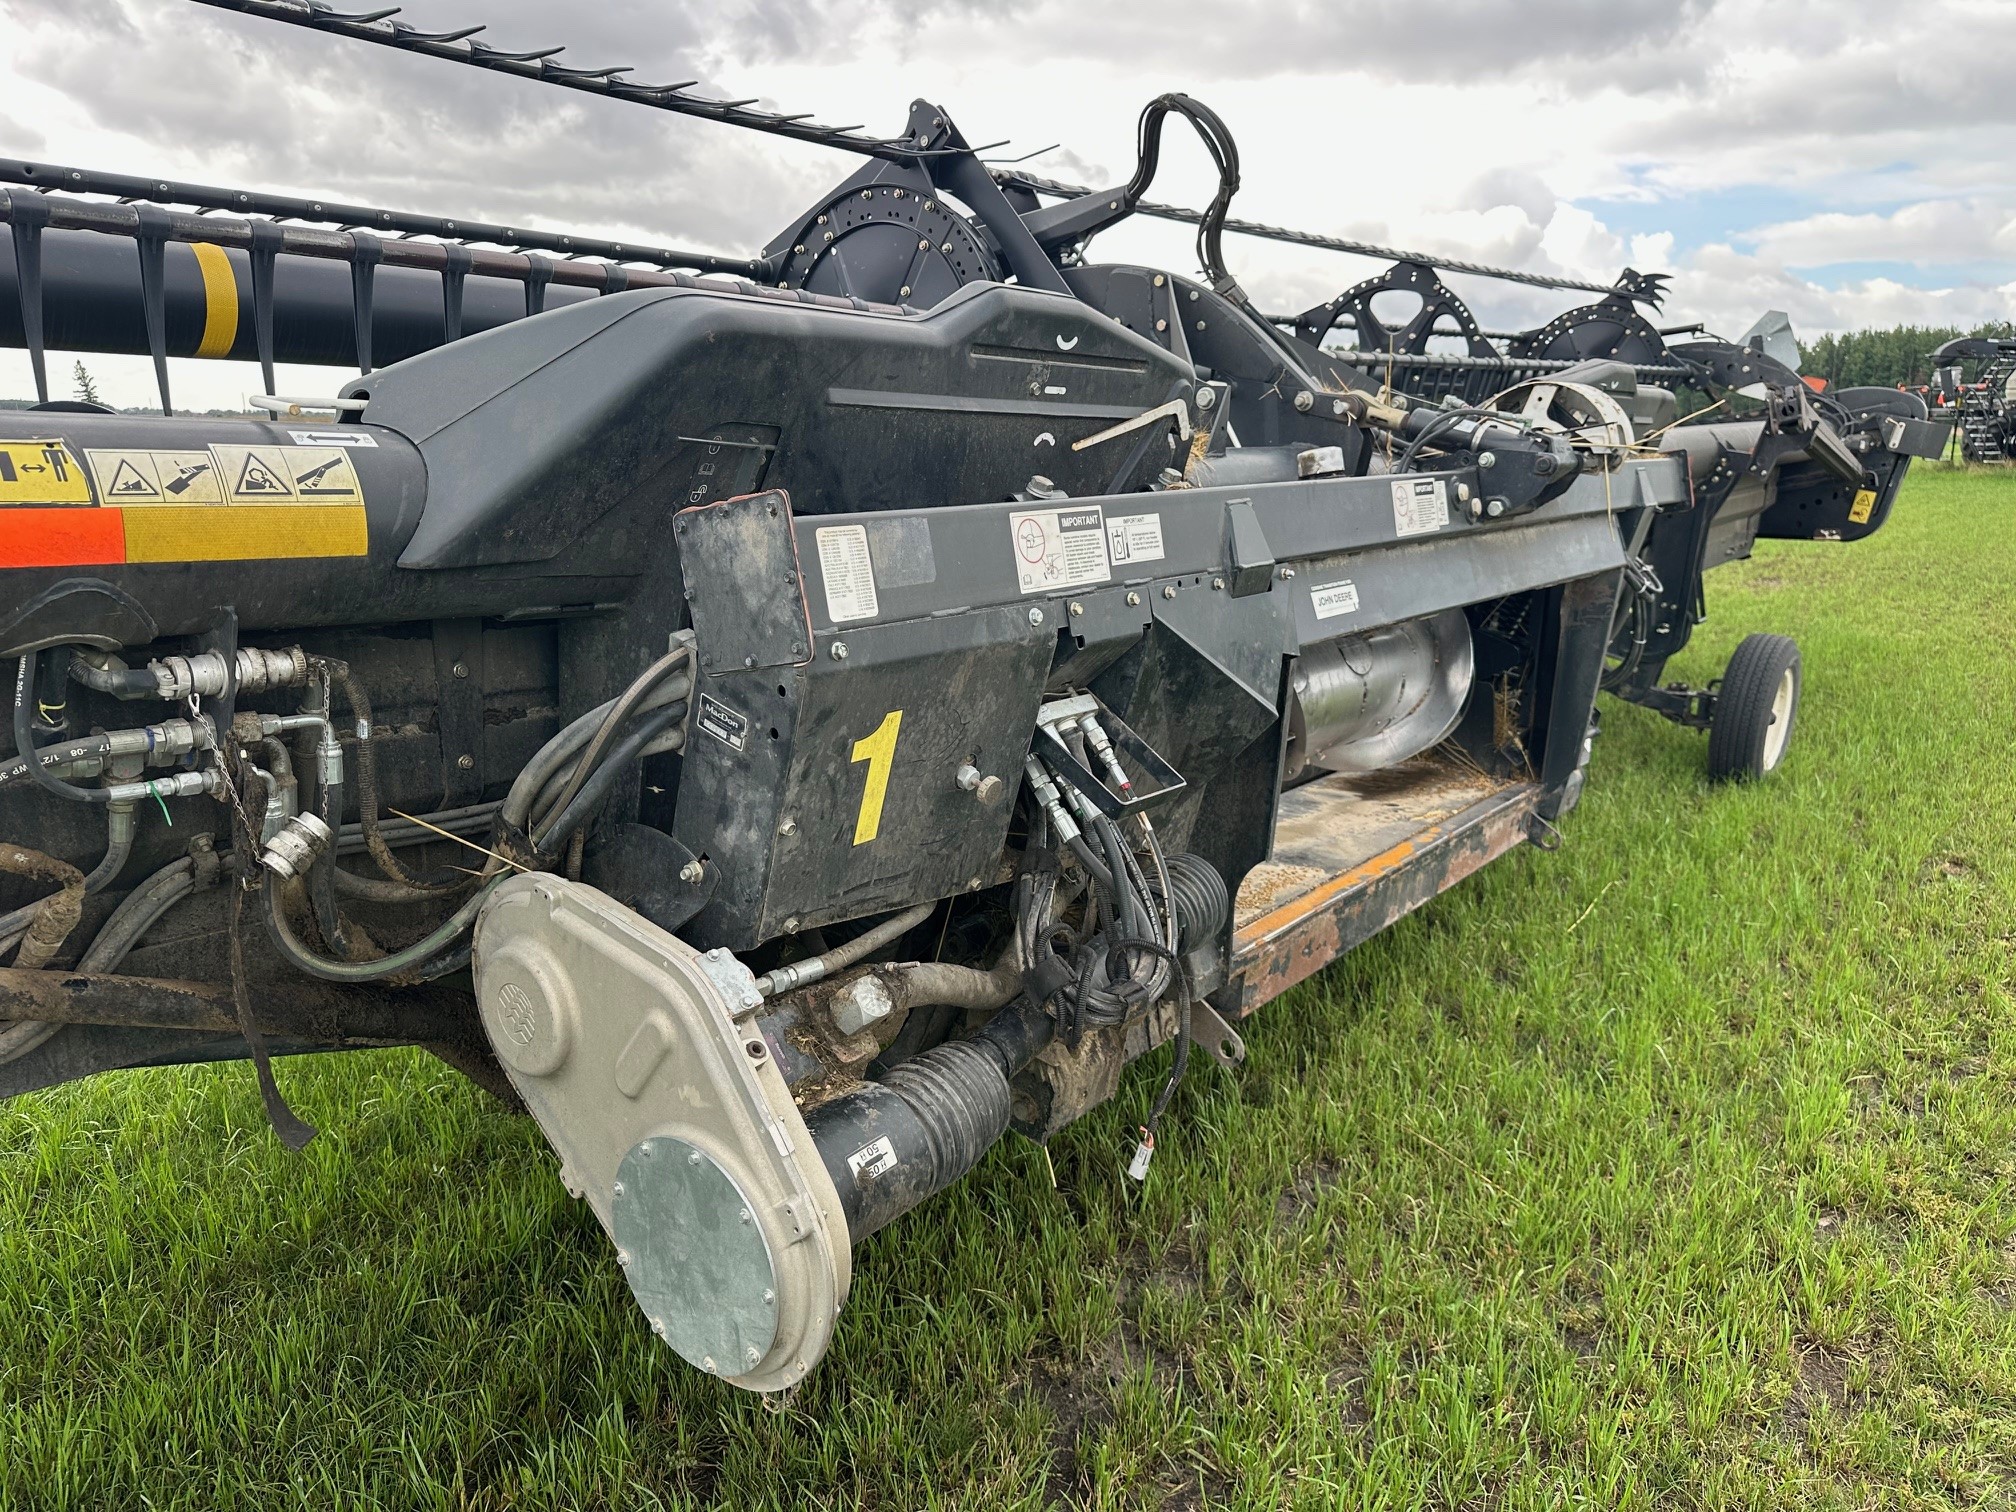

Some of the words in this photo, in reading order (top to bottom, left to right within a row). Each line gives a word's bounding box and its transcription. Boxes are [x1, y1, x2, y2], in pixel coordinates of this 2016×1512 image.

[1060, 515, 1099, 527] IMPORTANT
[1318, 595, 1334, 607] JOHN
[1333, 591, 1353, 603] DEERE
[705, 703, 739, 729] MacDon
[12, 763, 29, 775] WP
[851, 710, 903, 847] 1
